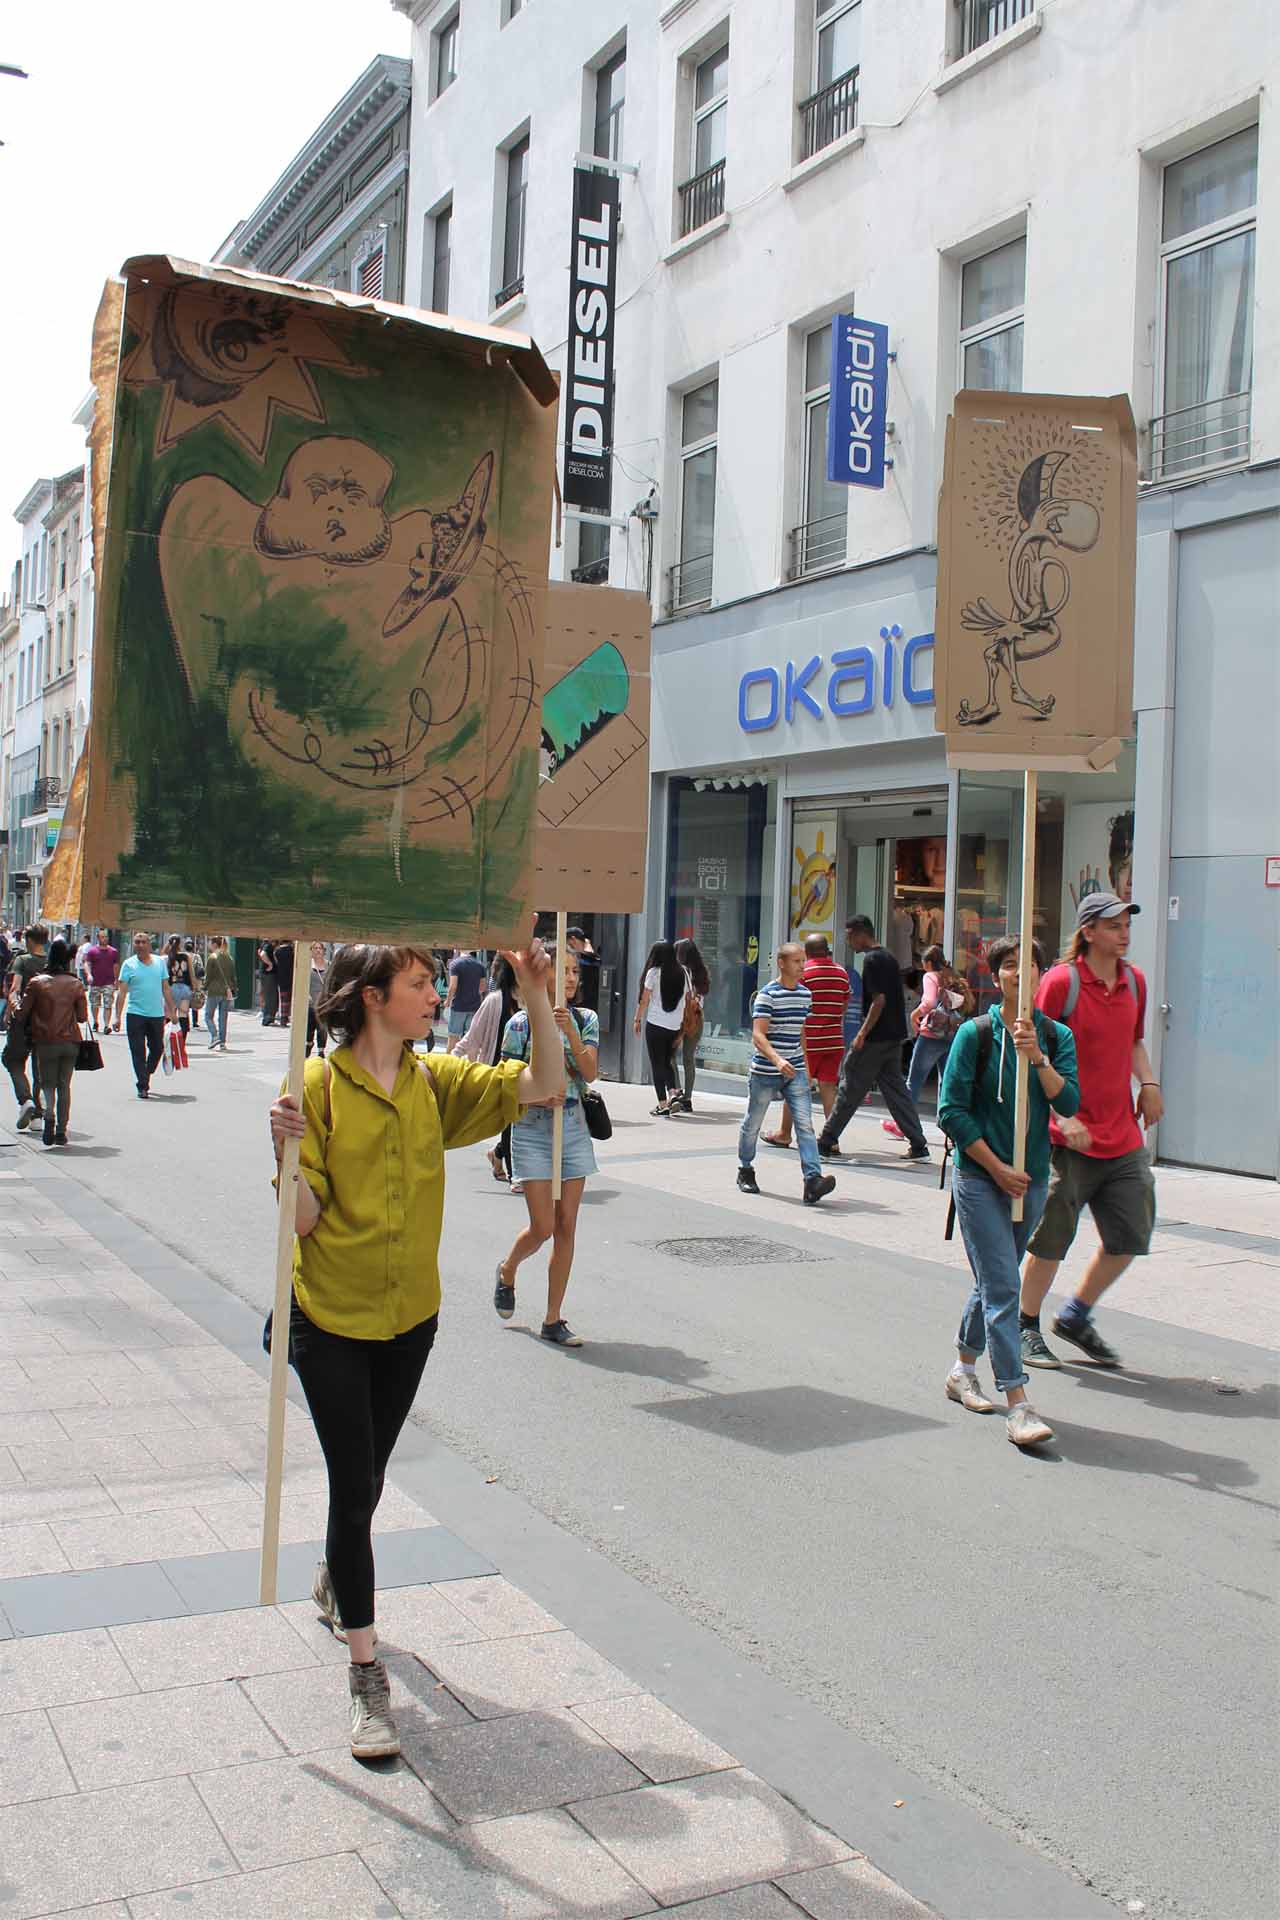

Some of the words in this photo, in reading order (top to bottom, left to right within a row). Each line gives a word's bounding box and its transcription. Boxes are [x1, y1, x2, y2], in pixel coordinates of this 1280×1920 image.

[571, 202, 610, 457] DIESEL
[845, 326, 875, 474] okaïdi
[738, 624, 936, 733] okaï
